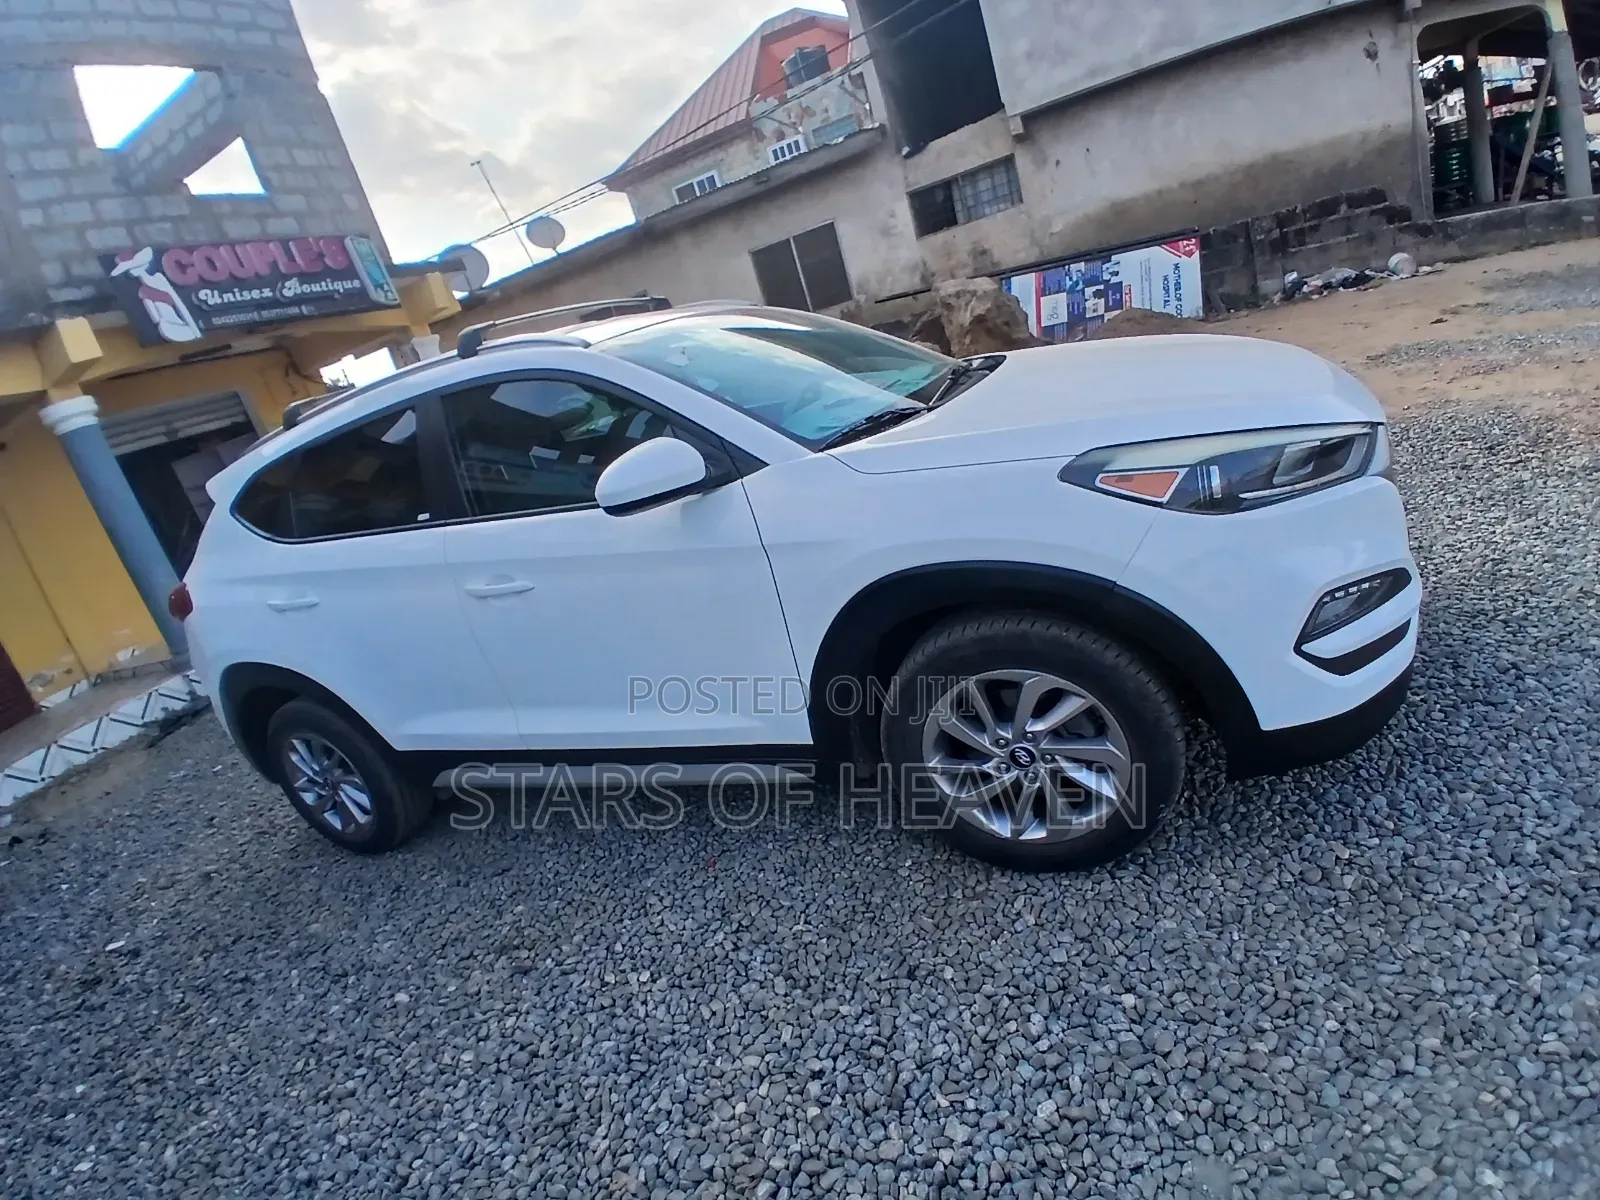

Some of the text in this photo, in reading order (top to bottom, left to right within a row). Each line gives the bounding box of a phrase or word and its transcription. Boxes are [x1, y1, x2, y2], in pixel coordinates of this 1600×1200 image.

[198, 277, 361, 305] Unisex Boutique
[1161, 274, 1171, 309] HOSPITAL
